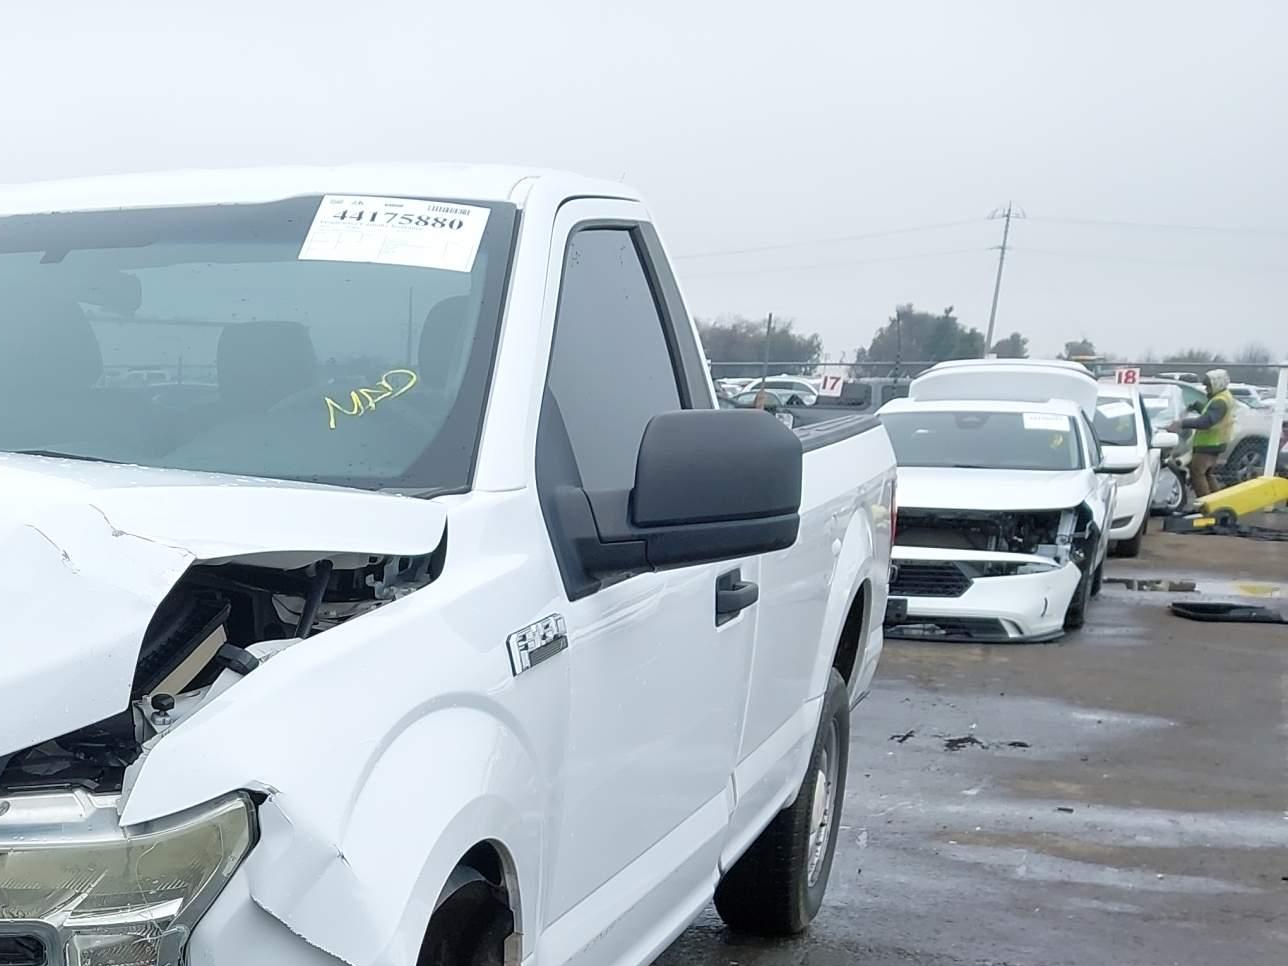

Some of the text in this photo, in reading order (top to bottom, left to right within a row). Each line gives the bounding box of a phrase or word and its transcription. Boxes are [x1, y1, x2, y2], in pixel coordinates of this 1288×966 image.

[332, 209, 464, 231] 44175880
[822, 375, 842, 390] 17
[1117, 370, 1137, 384] 18
